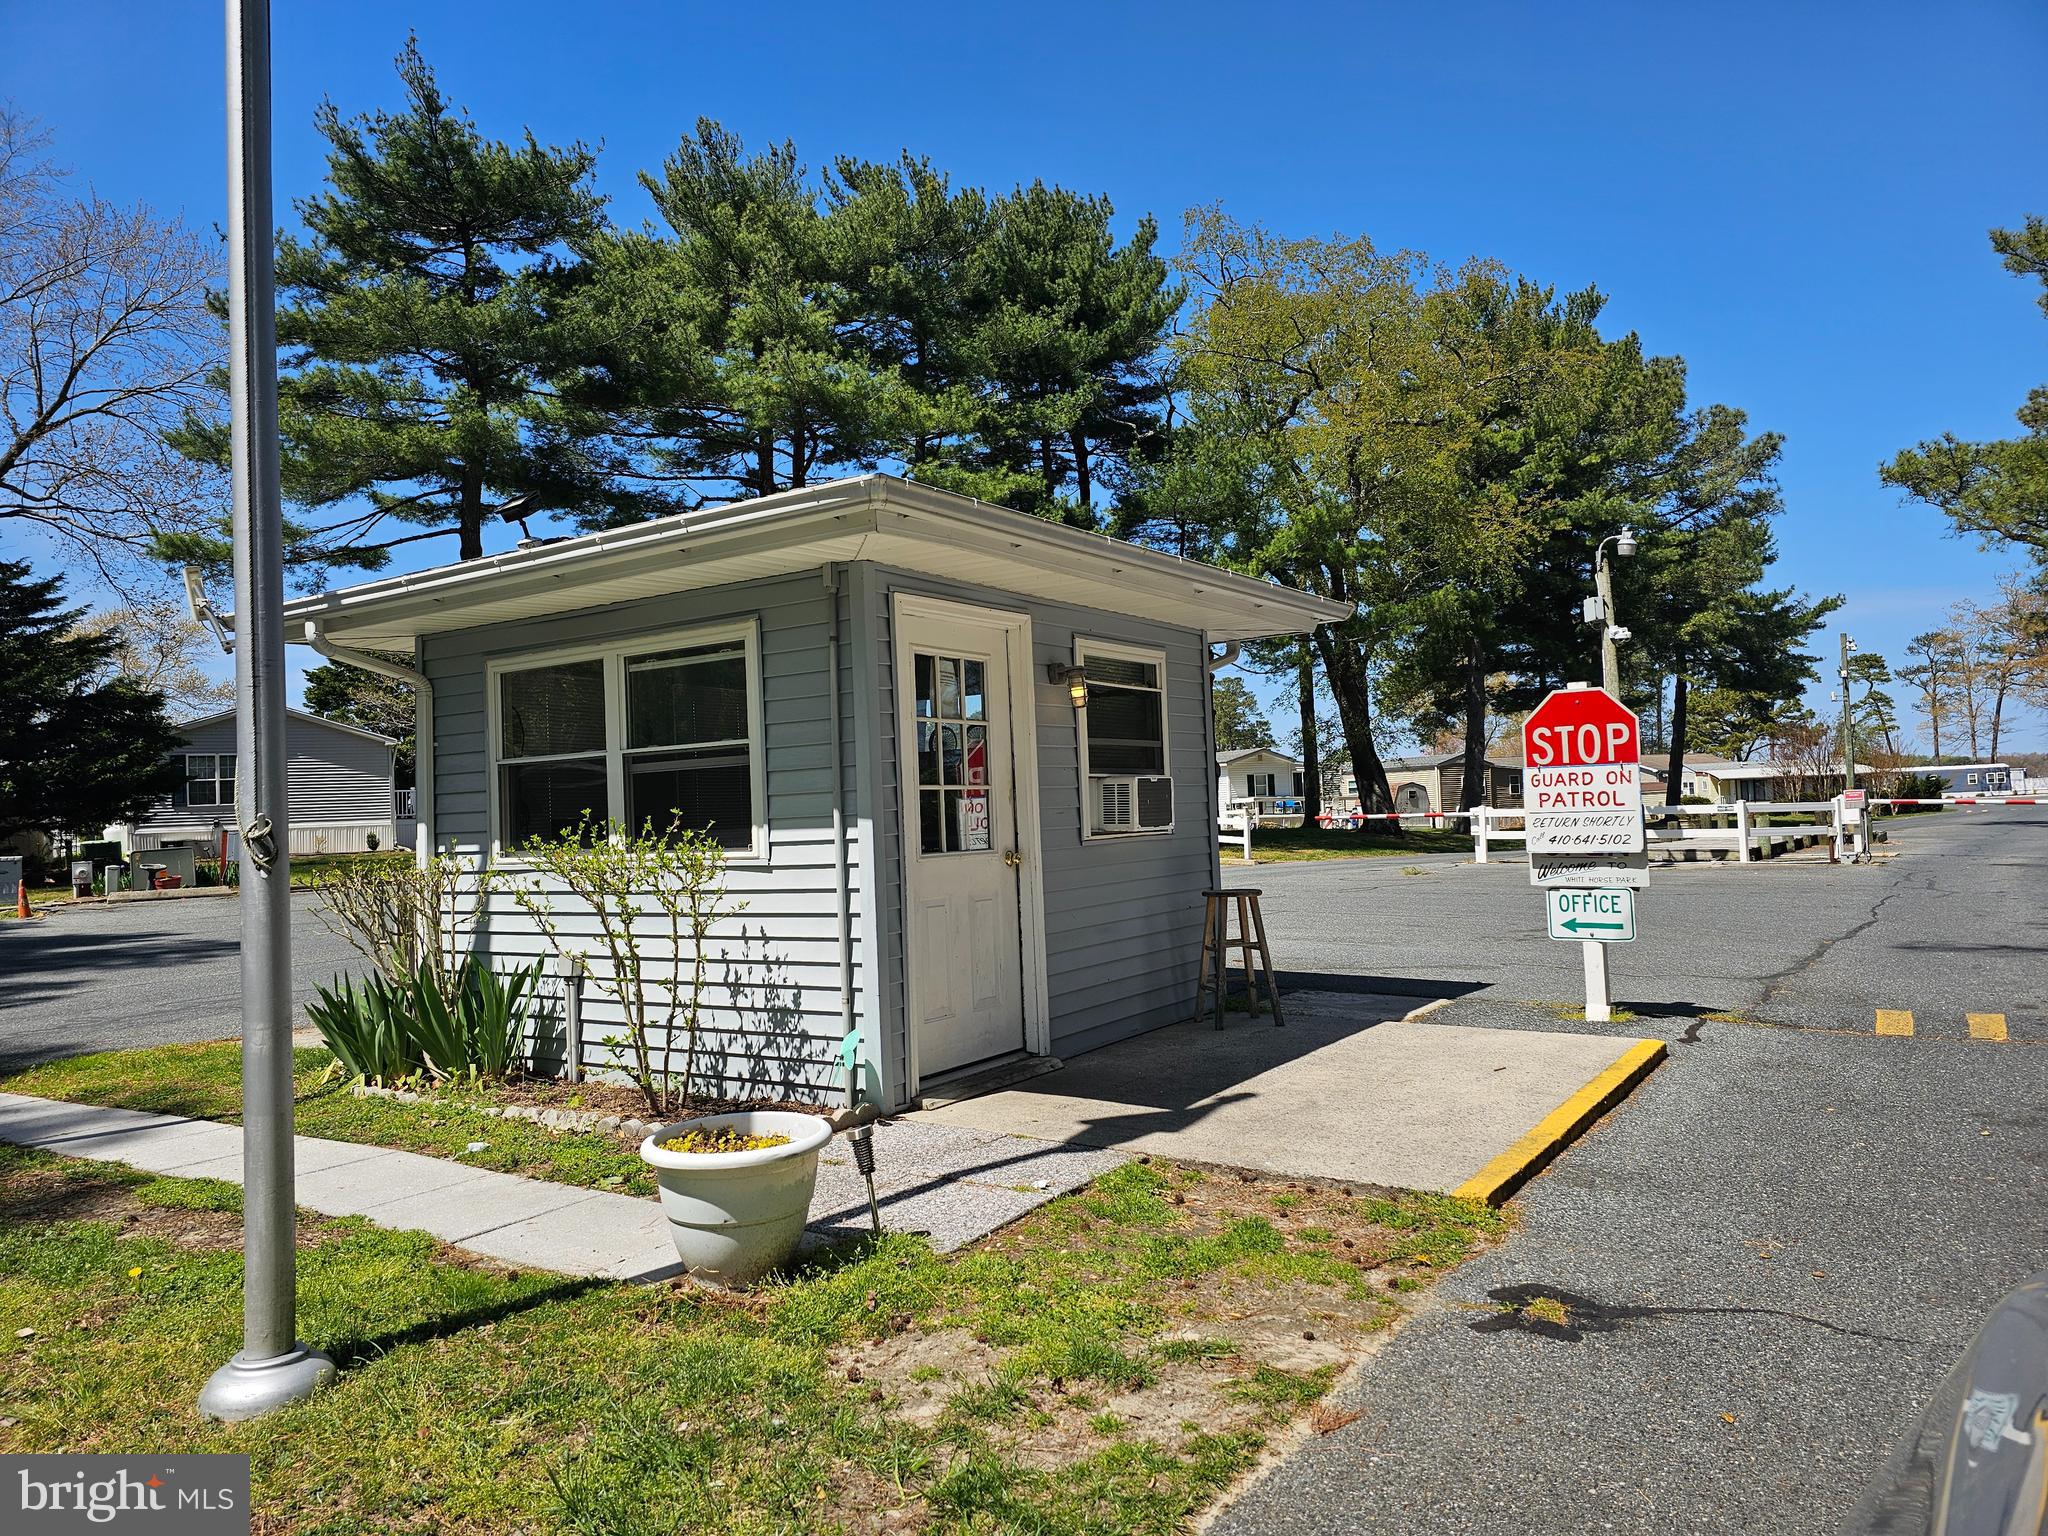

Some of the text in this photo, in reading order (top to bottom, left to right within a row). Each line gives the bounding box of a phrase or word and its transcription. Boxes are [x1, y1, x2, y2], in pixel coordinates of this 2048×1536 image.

[1532, 723, 1630, 765] STOP
[1531, 770, 1632, 788] GUARD ON
[1538, 791, 1626, 808] PATROL
[1532, 815, 1635, 829] RETURN SHORTLY
[1537, 861, 1627, 880] Welcome TO
[1616, 876, 1638, 884] PARK
[1559, 894, 1622, 914] OFFICE
